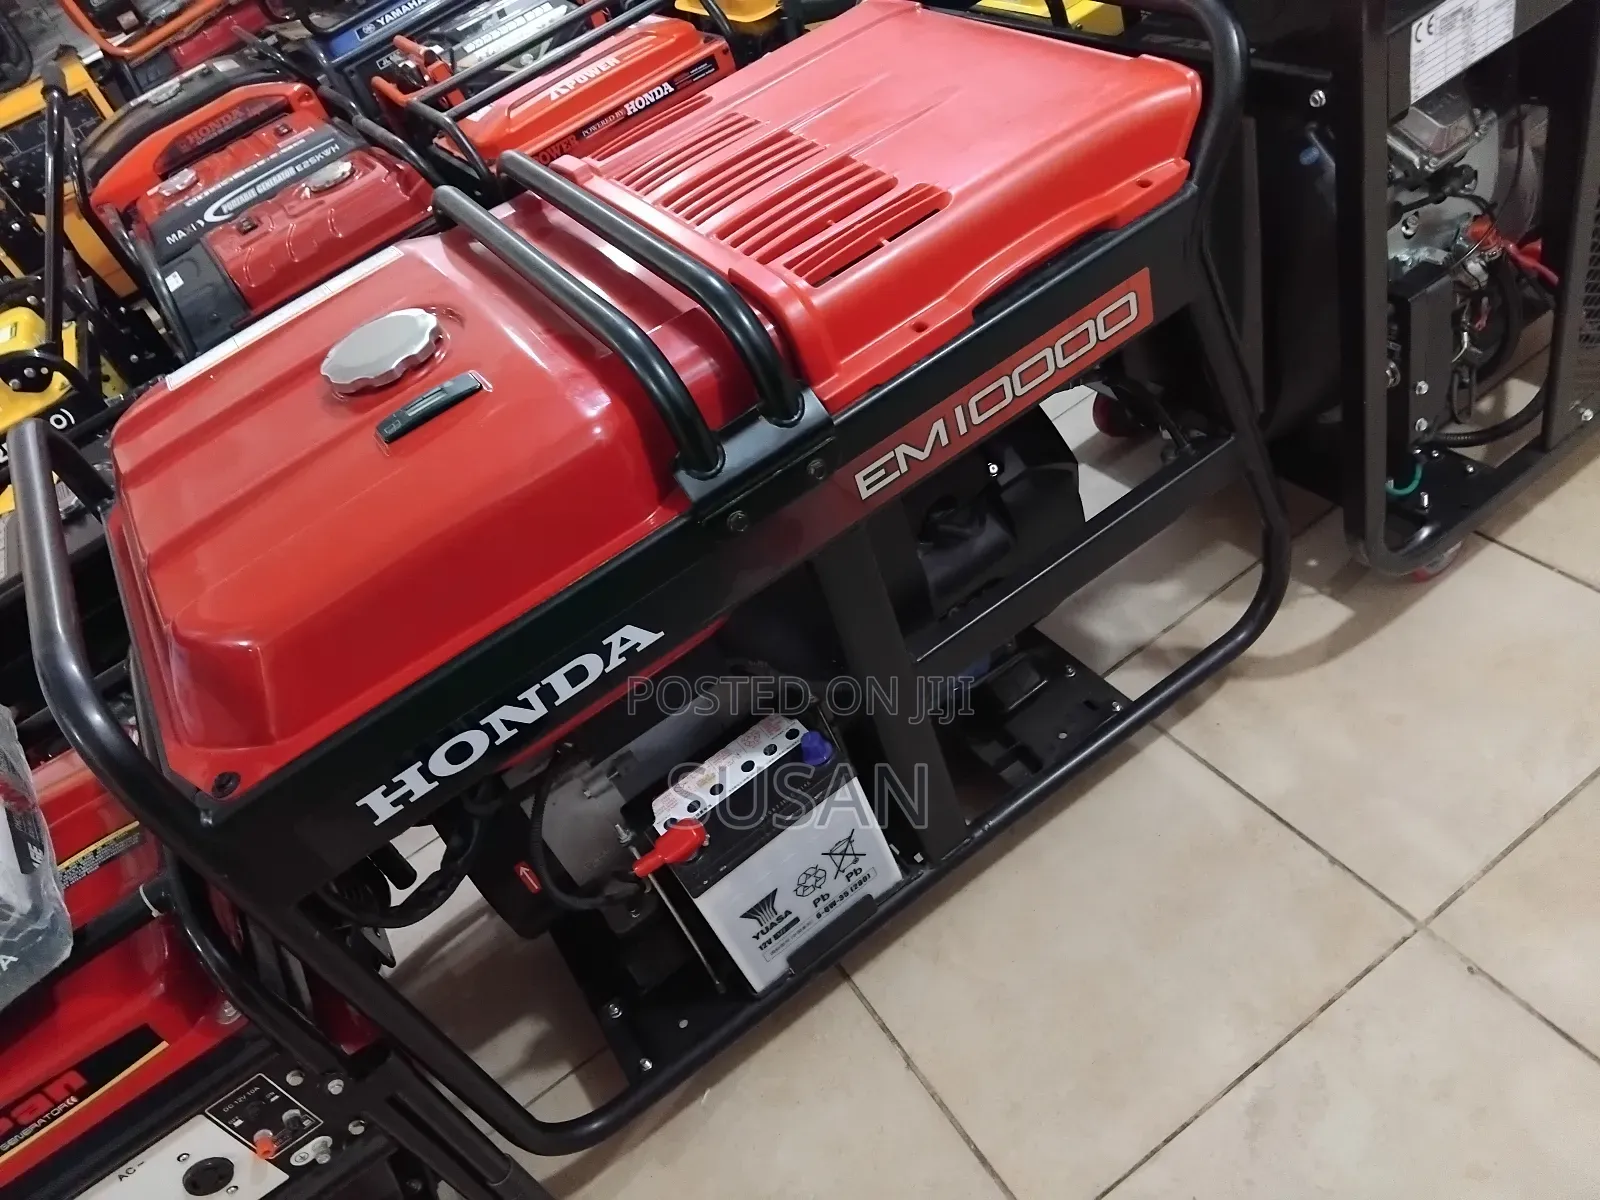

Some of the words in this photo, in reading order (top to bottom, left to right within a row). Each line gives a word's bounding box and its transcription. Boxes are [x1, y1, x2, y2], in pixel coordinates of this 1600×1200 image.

[376, 0, 427, 26] YAMAHA
[582, 114, 615, 138] POWERED
[624, 81, 675, 116] HONDA
[256, 165, 297, 194] GENERATOR
[854, 291, 1139, 500] EM10000
[355, 624, 665, 826] HONDA
[845, 867, 863, 882] Pb
[812, 892, 831, 908] Pb
[752, 909, 792, 941] YUASA
[758, 938, 773, 951] 12V
[222, 1104, 235, 1113] DC
[234, 1095, 247, 1104] 12V
[0, 1102, 69, 1152] GENERATOR
